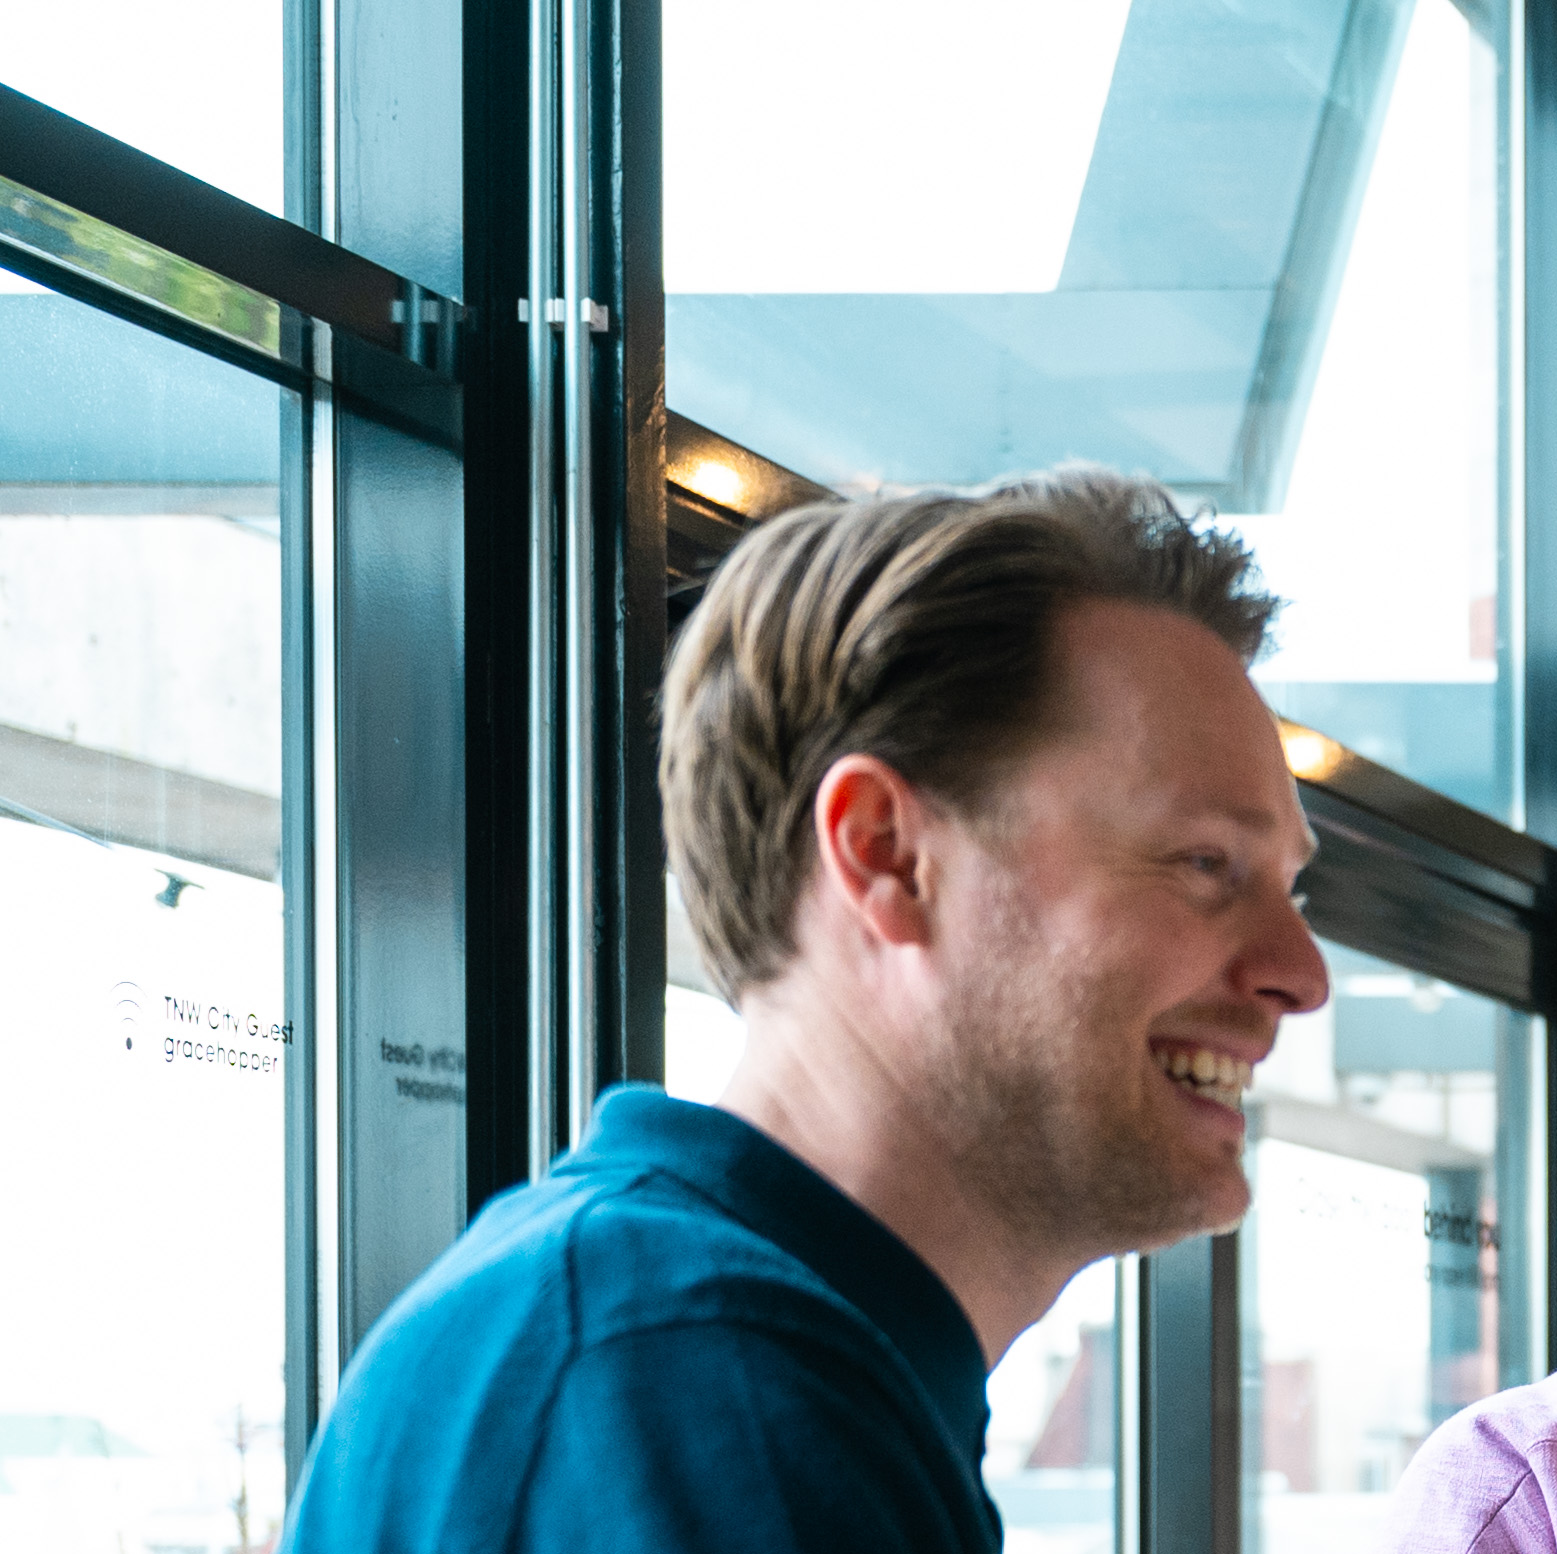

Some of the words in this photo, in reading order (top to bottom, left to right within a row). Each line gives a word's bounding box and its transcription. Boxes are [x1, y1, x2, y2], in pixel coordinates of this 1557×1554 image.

[164, 996, 201, 1025] TNW
[207, 1006, 240, 1038] City
[246, 1013, 294, 1045] Guest
[164, 1037, 278, 1074] gracehopper
